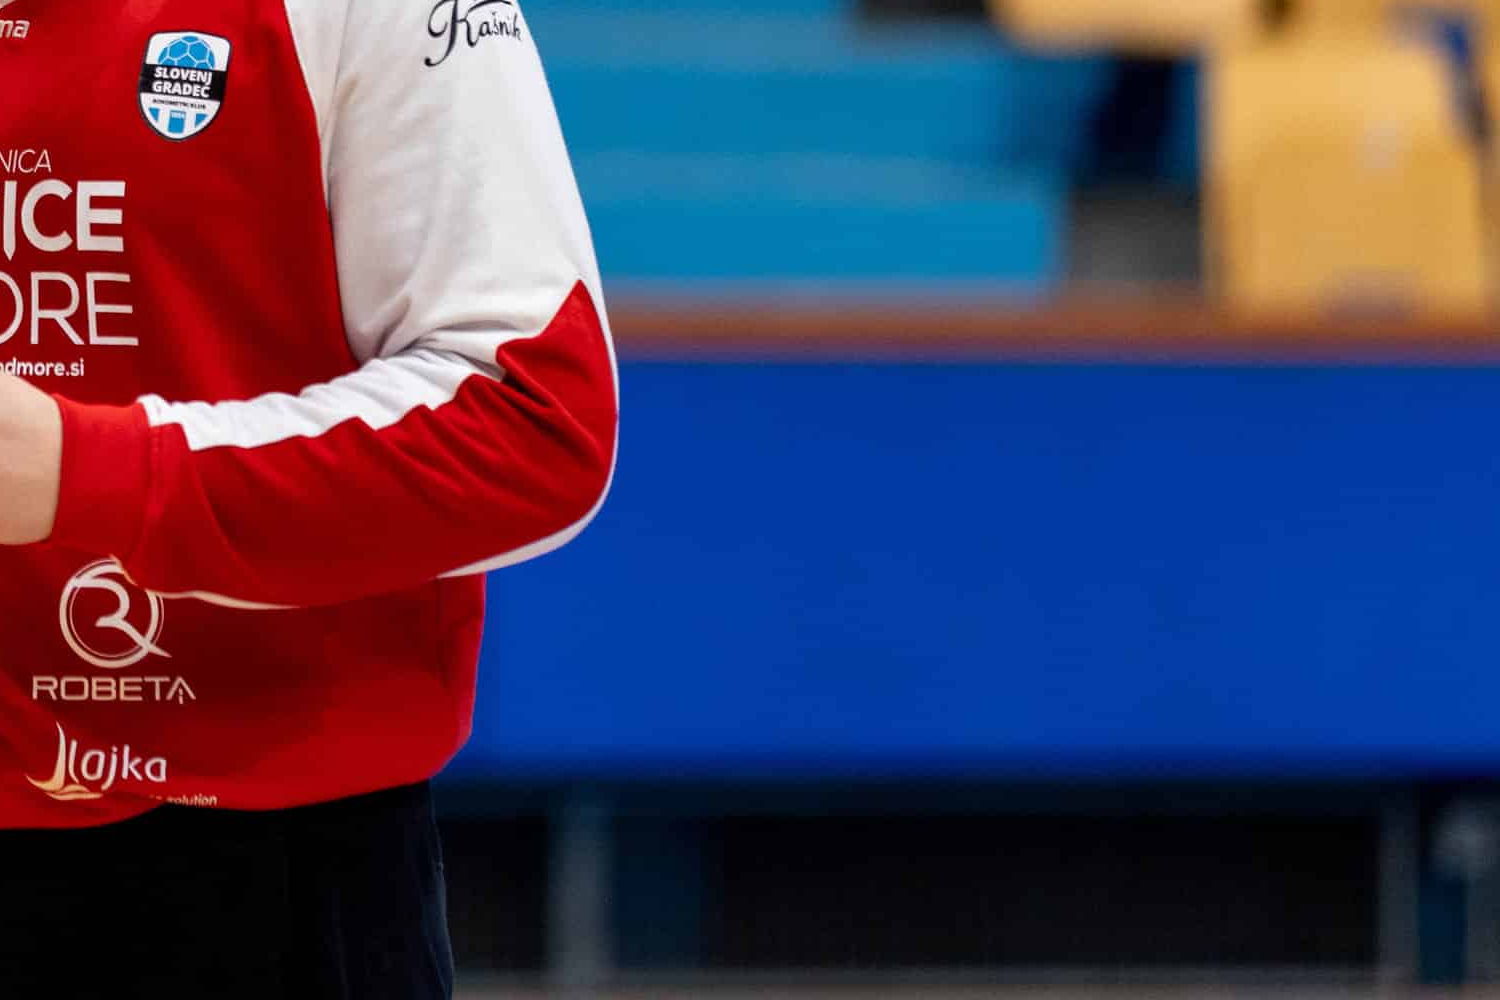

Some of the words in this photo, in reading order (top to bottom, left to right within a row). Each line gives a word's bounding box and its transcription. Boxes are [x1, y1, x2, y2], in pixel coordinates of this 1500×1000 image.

[153, 66, 213, 86] SLOVENJ
[151, 80, 211, 98] GRADEC
[32, 675, 197, 705] ROBETA
